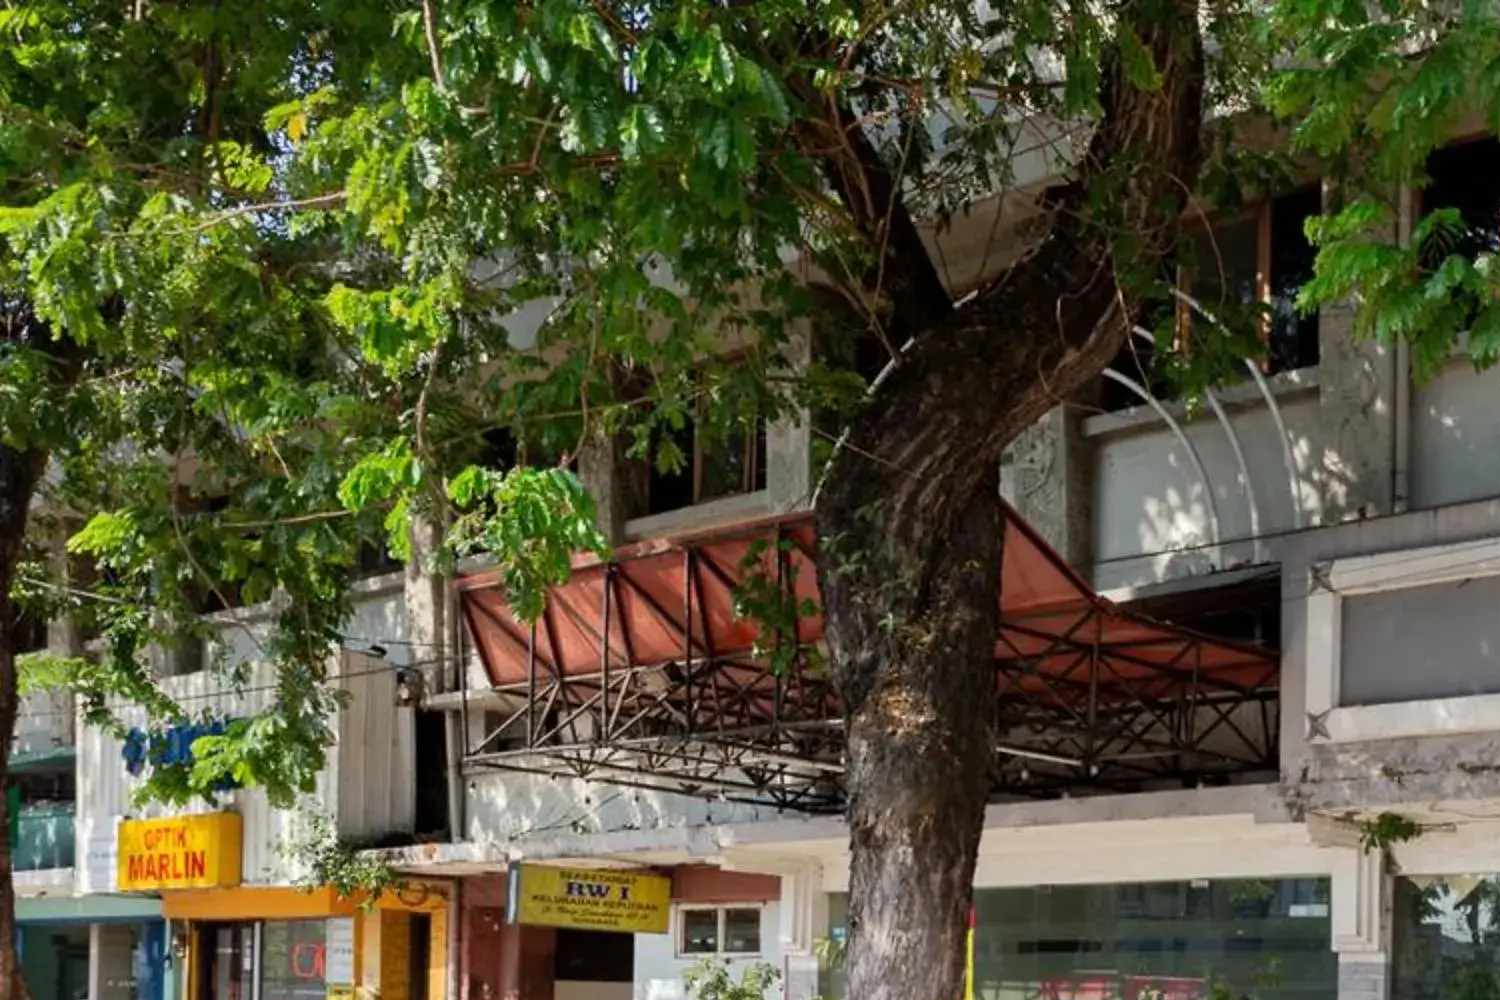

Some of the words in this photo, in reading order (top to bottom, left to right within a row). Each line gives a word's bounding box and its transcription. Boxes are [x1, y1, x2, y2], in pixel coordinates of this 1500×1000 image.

[143, 826, 186, 850] OPTIK
[128, 850, 205, 881] MARLIN
[566, 881, 610, 898] RW
